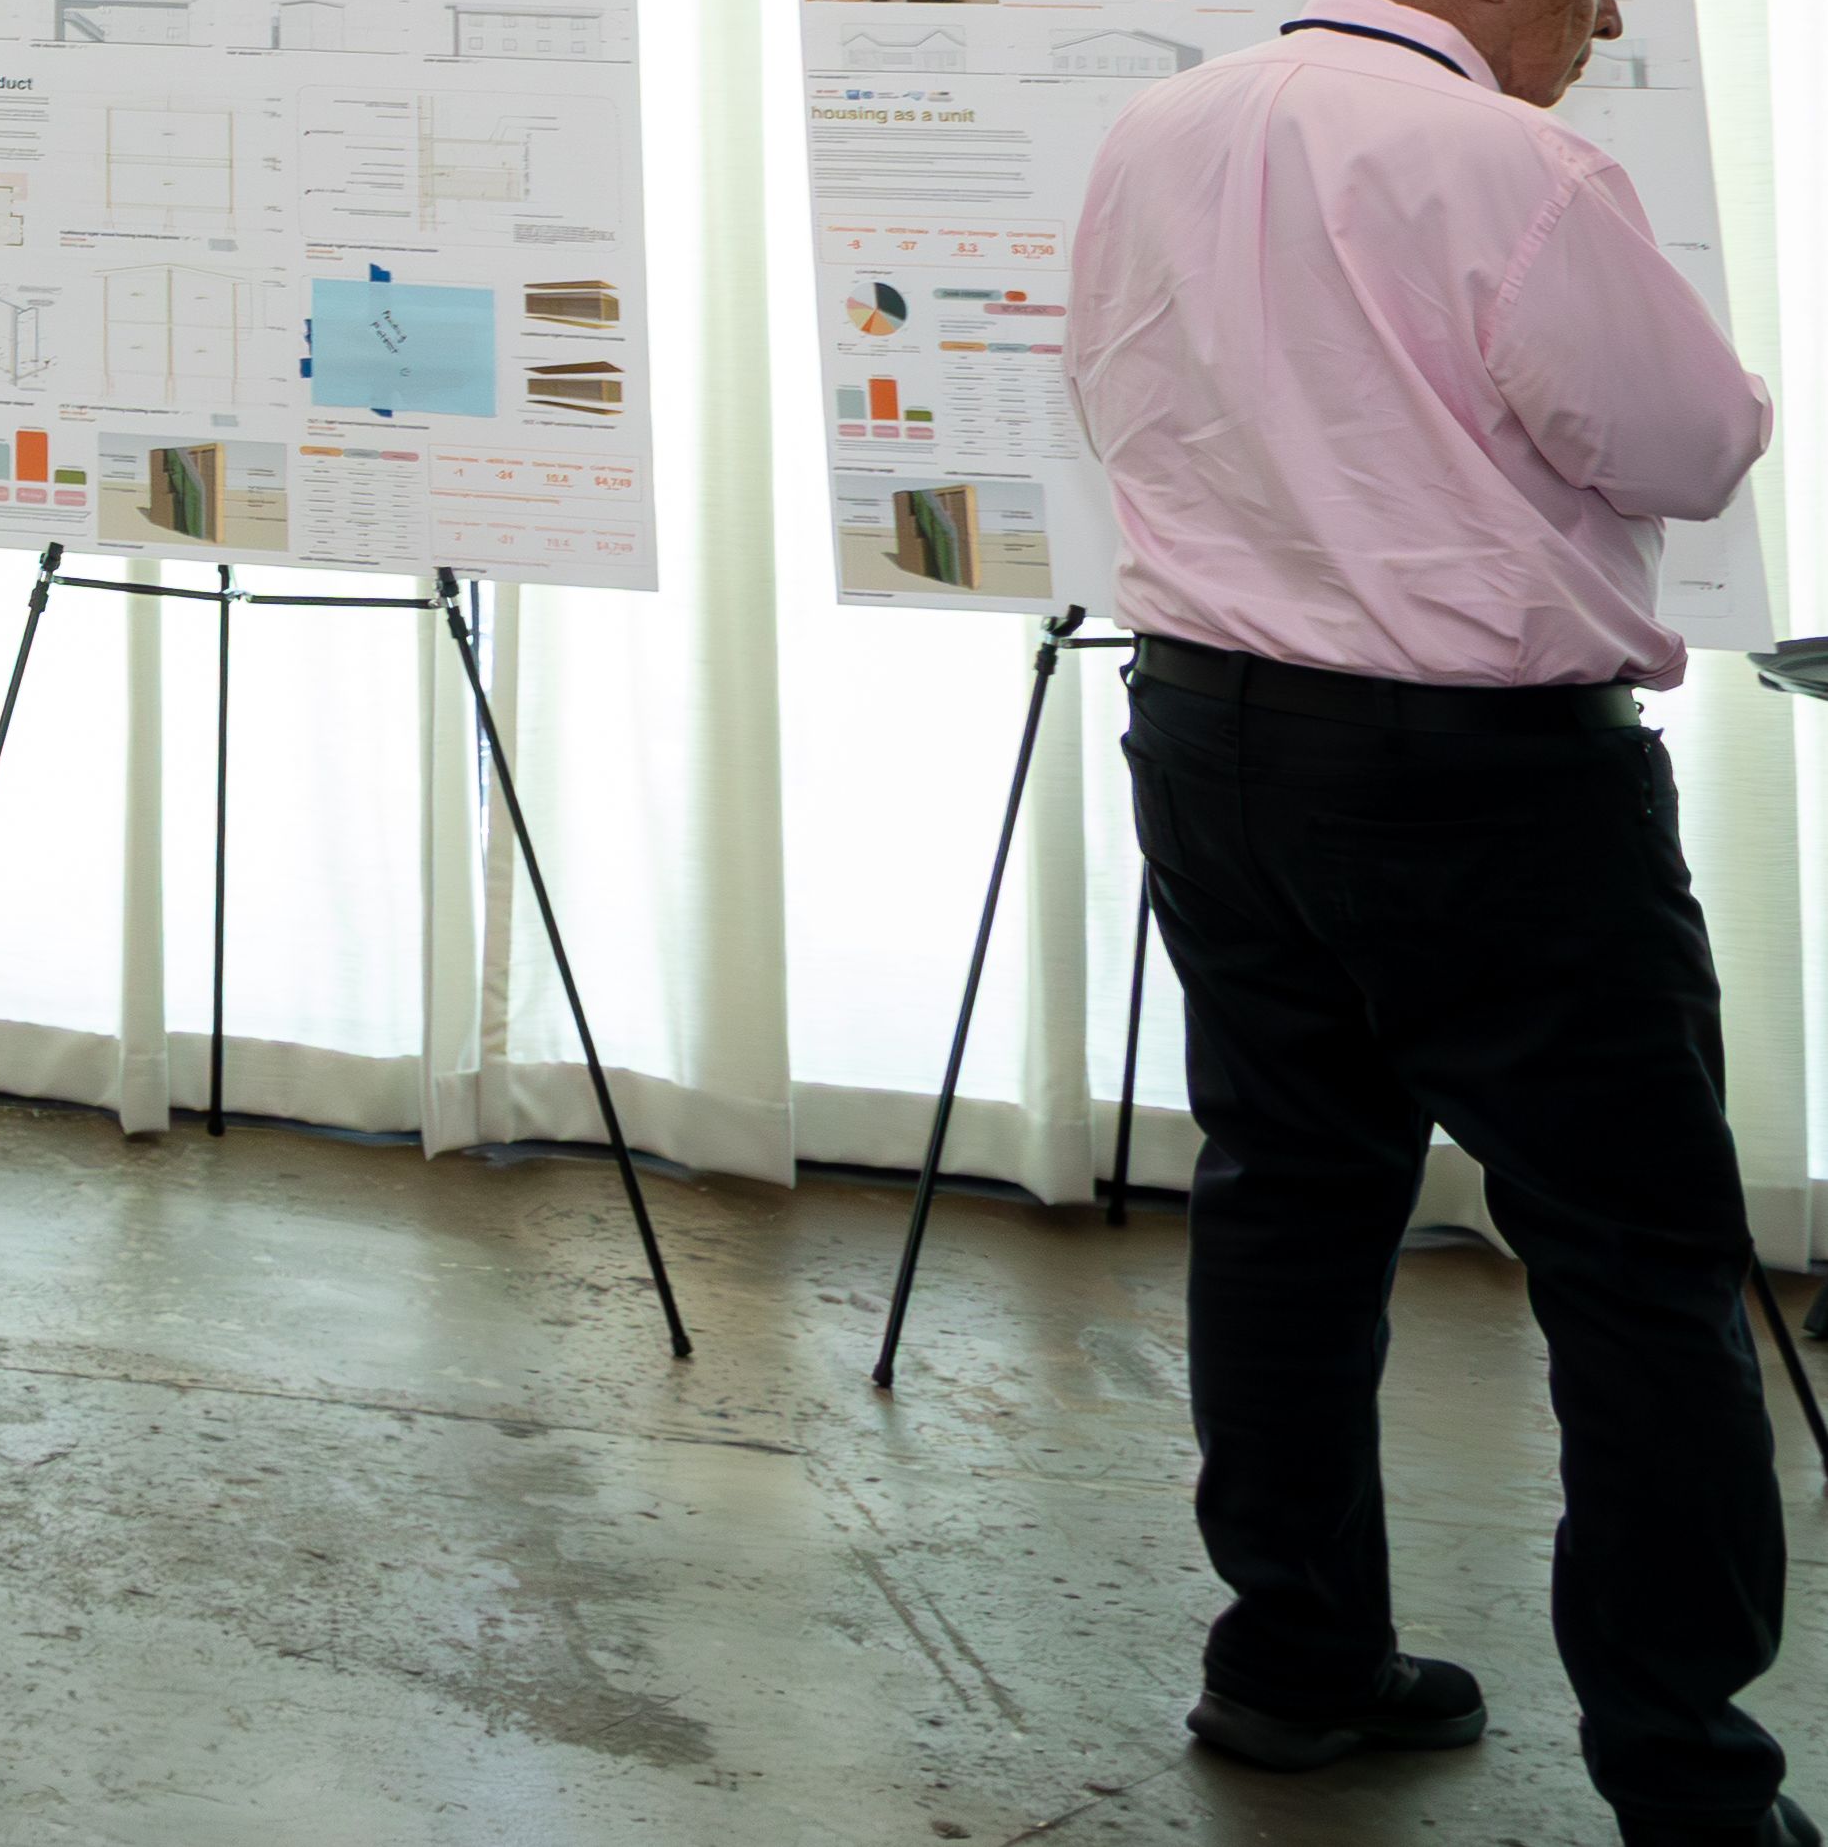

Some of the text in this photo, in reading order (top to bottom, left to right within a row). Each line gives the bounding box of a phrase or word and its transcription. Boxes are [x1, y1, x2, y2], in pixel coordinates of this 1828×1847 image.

[811, 106, 976, 124] housing as a unit
